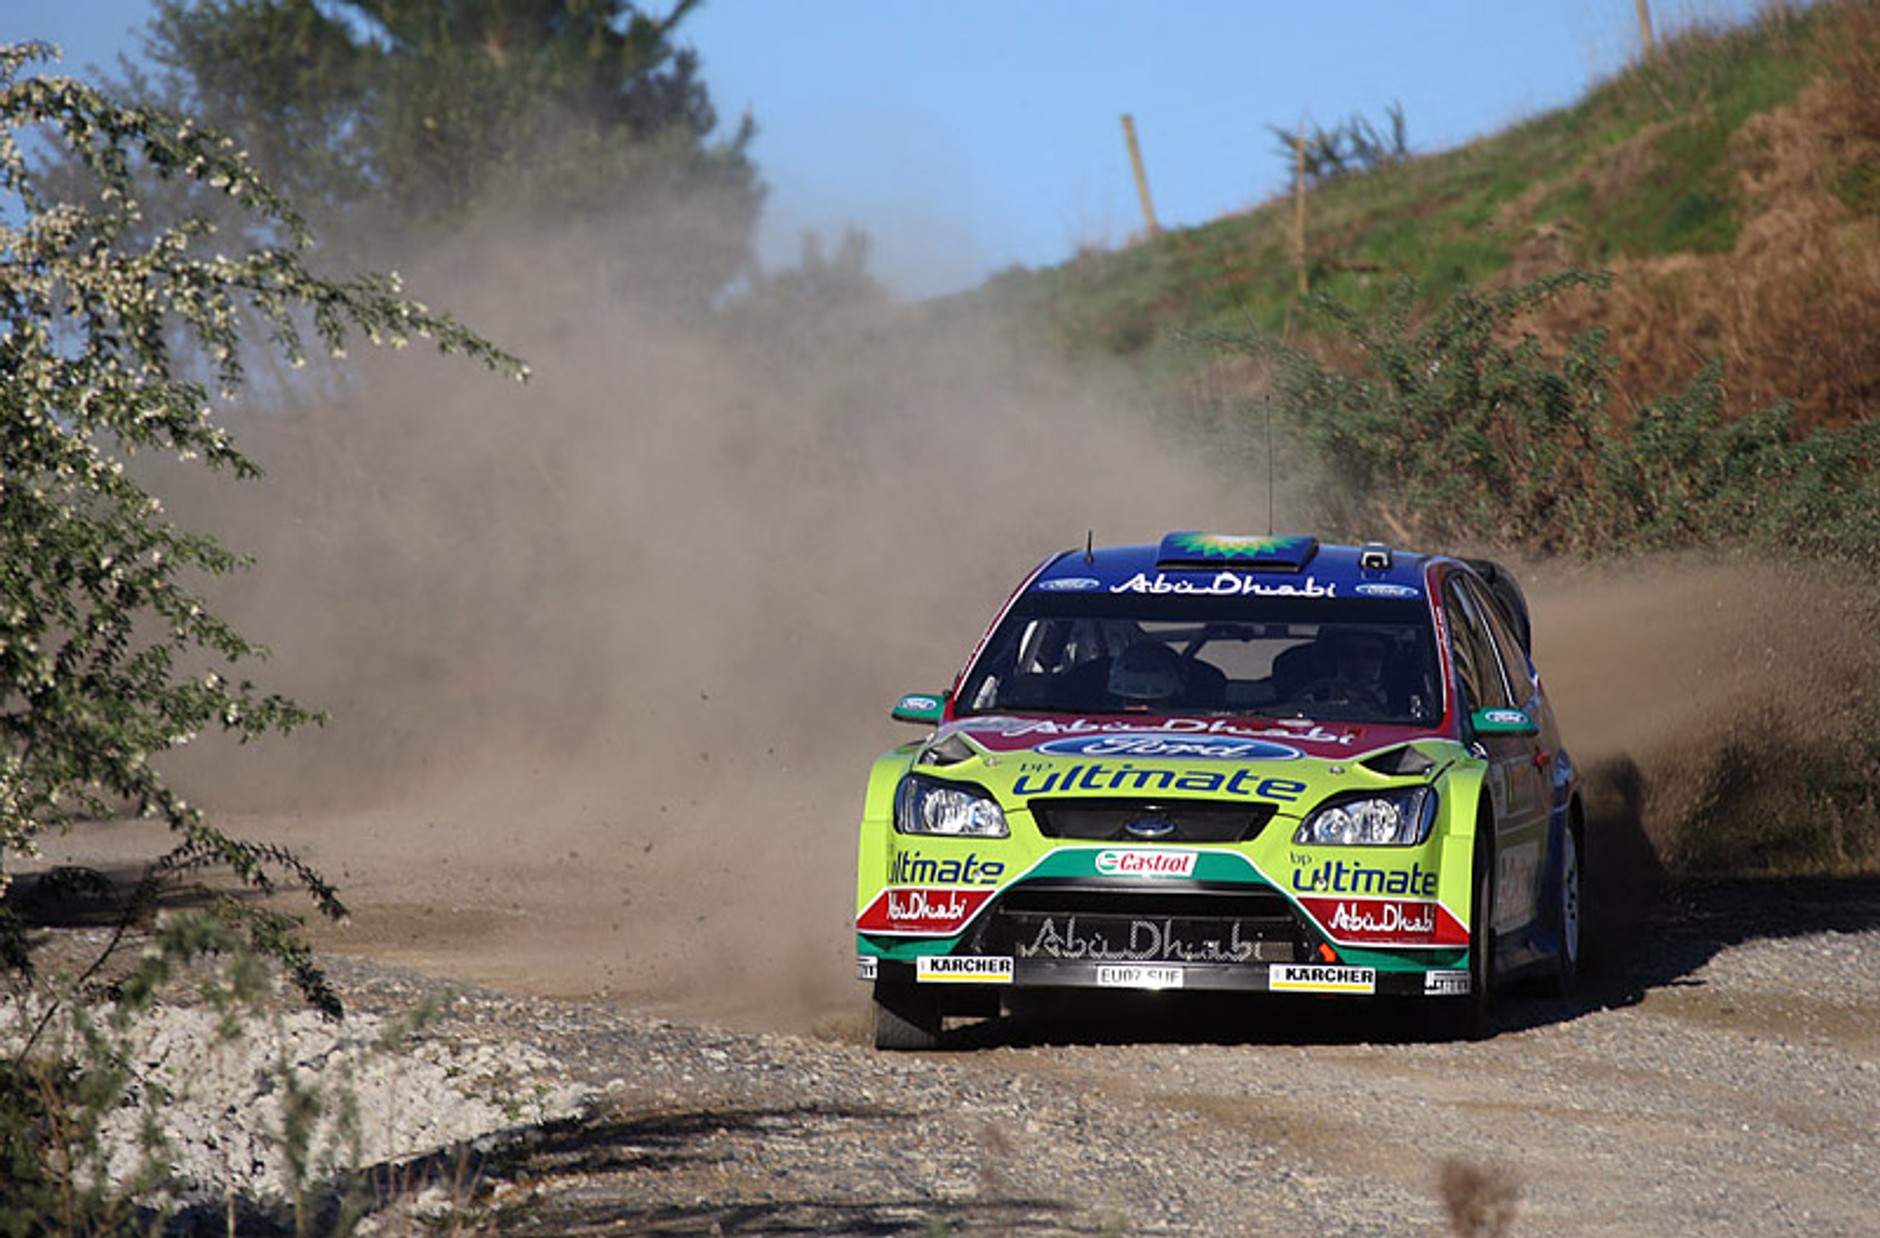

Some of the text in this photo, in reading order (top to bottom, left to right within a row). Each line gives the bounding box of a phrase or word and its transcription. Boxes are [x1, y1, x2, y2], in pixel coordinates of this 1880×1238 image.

[1210, 571, 1336, 597] Dhabi
[1162, 718, 1355, 745] Dhabi
[1083, 738, 1256, 757] Ford
[1013, 764, 1307, 801] ultimate
[1120, 853, 1190, 873] Castrol
[1293, 860, 1438, 896] ultimate
[908, 891, 967, 920] Dhabi
[1381, 903, 1435, 933] Dhabi
[1126, 917, 1264, 961] Dhabi
